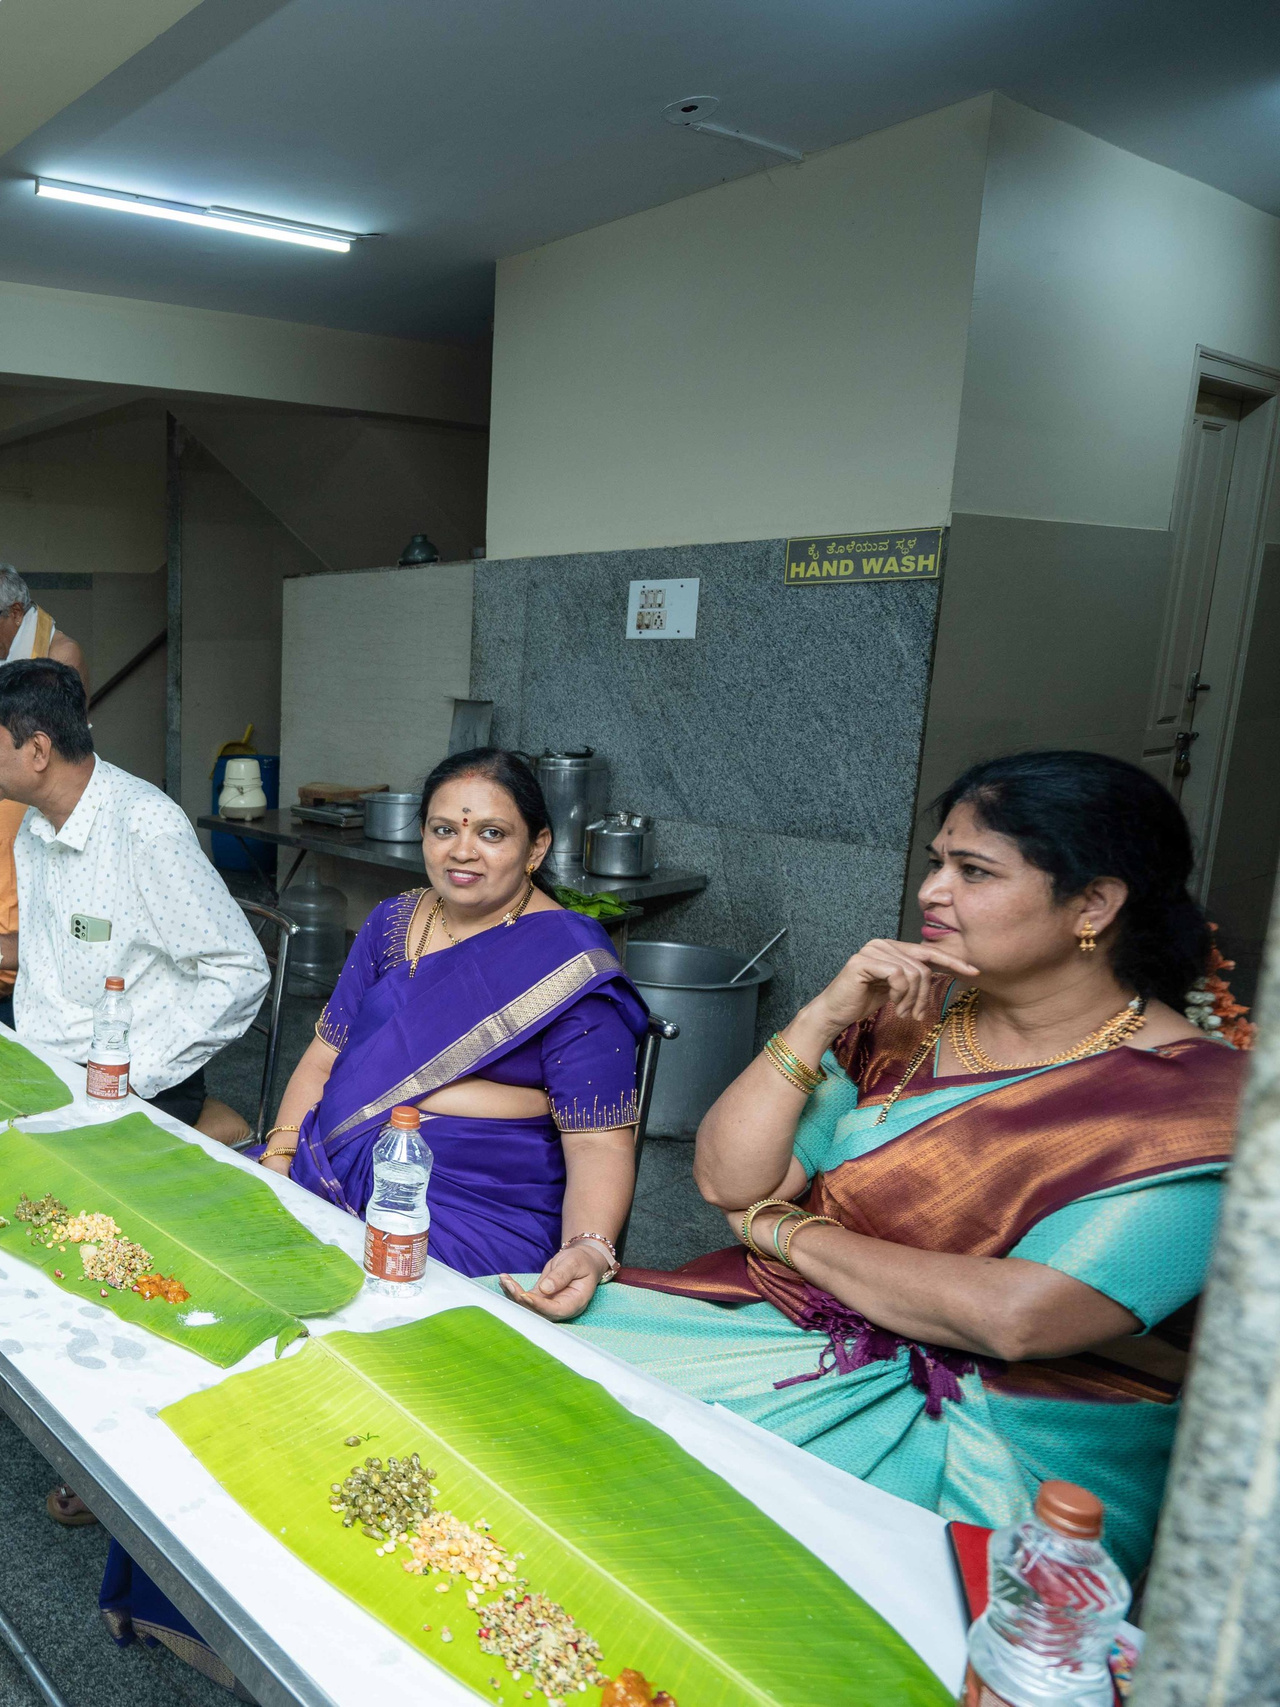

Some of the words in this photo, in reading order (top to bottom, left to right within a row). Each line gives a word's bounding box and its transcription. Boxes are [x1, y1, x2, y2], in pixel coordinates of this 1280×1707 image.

[808, 543, 819, 560] ಕೈ
[895, 537, 917, 555] ಸ್ಥಳ
[790, 559, 854, 578] HAND
[862, 554, 935, 575] WASH
